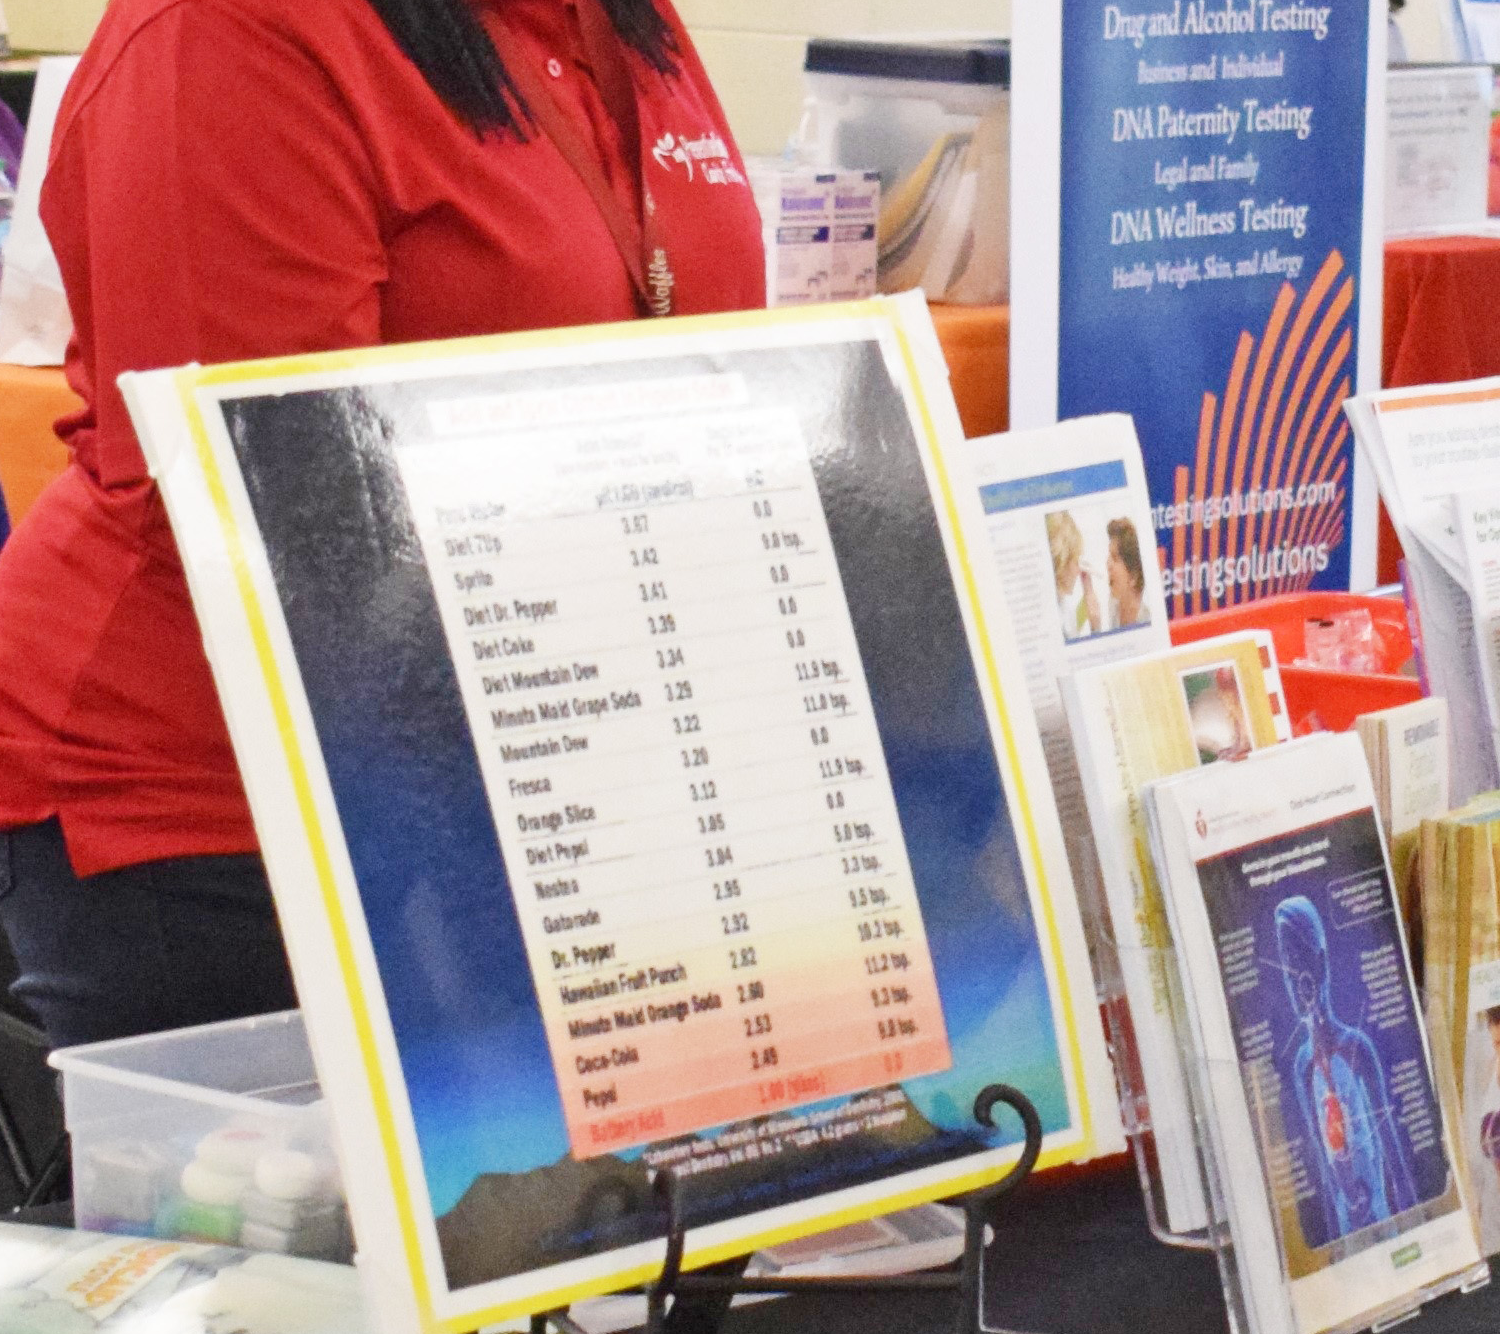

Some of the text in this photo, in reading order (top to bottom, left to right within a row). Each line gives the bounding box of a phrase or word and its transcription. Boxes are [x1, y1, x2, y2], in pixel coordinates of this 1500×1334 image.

[1103, 5, 1146, 49] Drug
[1148, 0, 1181, 36] and
[1112, 98, 1313, 145] DNA Paternity Testing
[1110, 198, 1309, 245] DNA Wellness Testing
[463, 604, 492, 626] Diet
[493, 602, 511, 621] Dr.
[513, 594, 559, 623] Pepper
[472, 639, 501, 660] Diet
[501, 634, 535, 656] Coke
[481, 673, 511, 695] Diet
[510, 662, 571, 690] Mountain
[572, 659, 599, 680] Dew
[499, 737, 561, 764] Mountain
[561, 732, 589, 753] Dew
[508, 773, 552, 799] Fresca
[516, 808, 565, 838] Orange
[564, 802, 596, 825] Slice
[525, 844, 554, 867] Diet
[554, 838, 591, 865] Pepsi
[533, 875, 580, 902] Nestea
[542, 906, 601, 935] Gatorade
[550, 949, 570, 970] Dr.
[572, 939, 619, 972] Pepper
[559, 976, 618, 1006] Hawaiian
[574, 1044, 639, 1077] Coca-Cola
[582, 1084, 619, 1112] Pepsi
